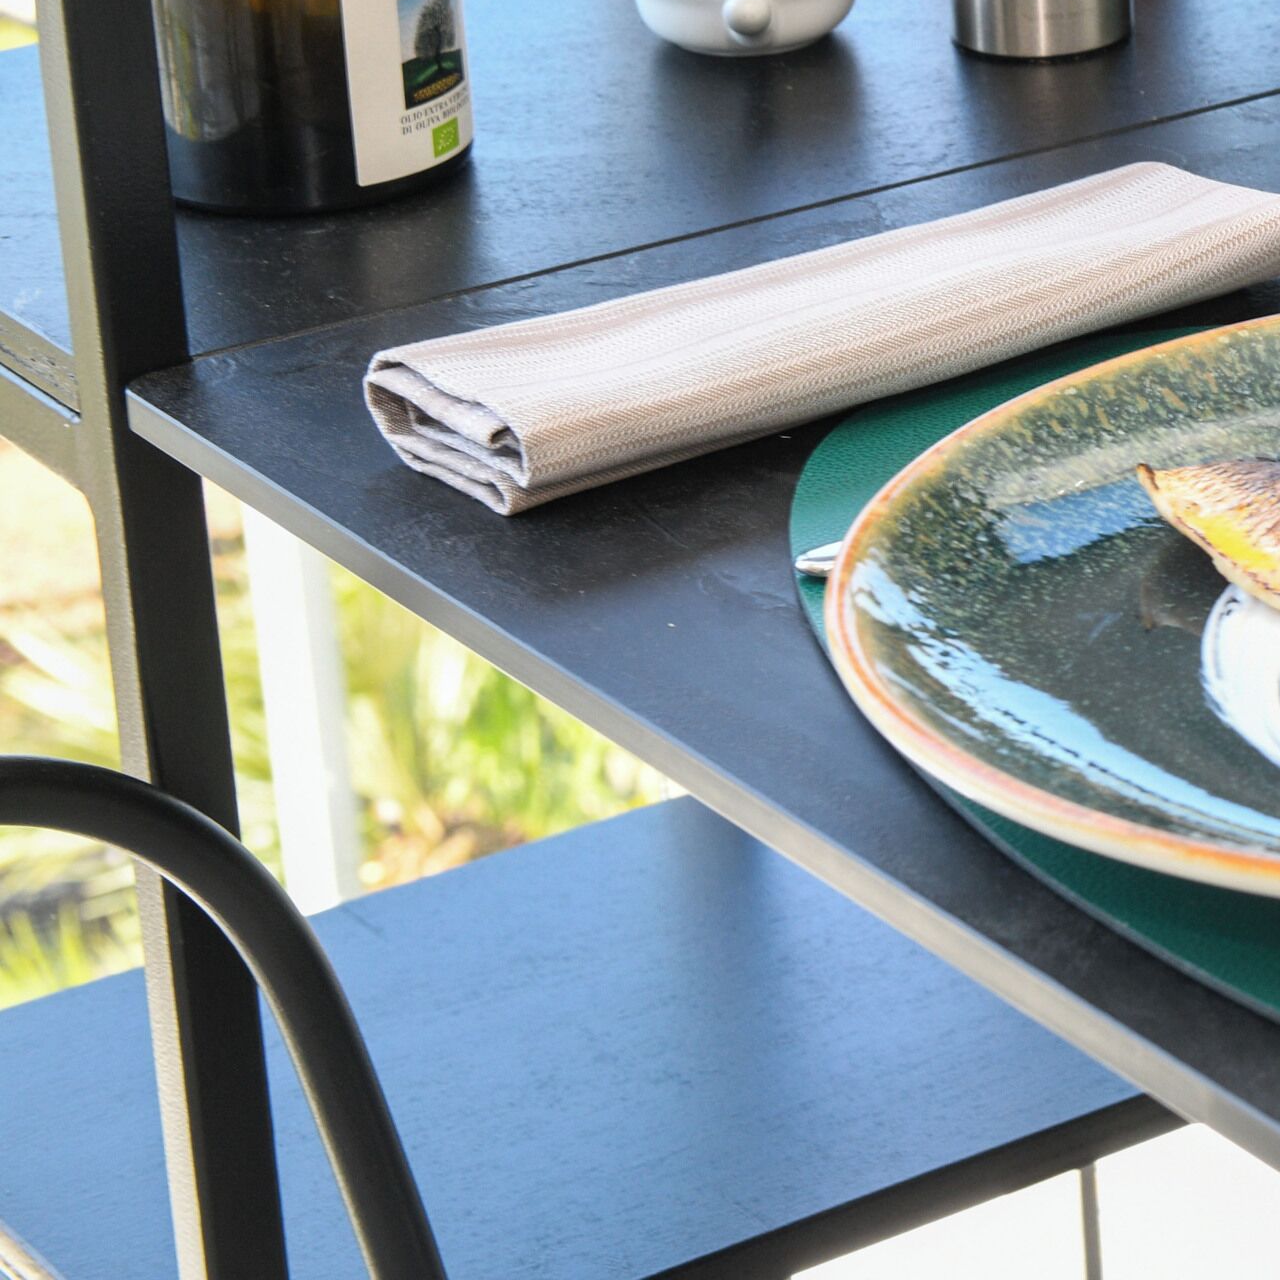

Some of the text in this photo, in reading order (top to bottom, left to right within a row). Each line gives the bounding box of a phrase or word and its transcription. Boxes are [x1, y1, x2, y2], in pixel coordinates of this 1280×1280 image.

[400, 111, 423, 125] OLIO
[424, 99, 448, 117] EXTRA
[402, 125, 413, 136] DI
[415, 115, 441, 131] OLIVA
